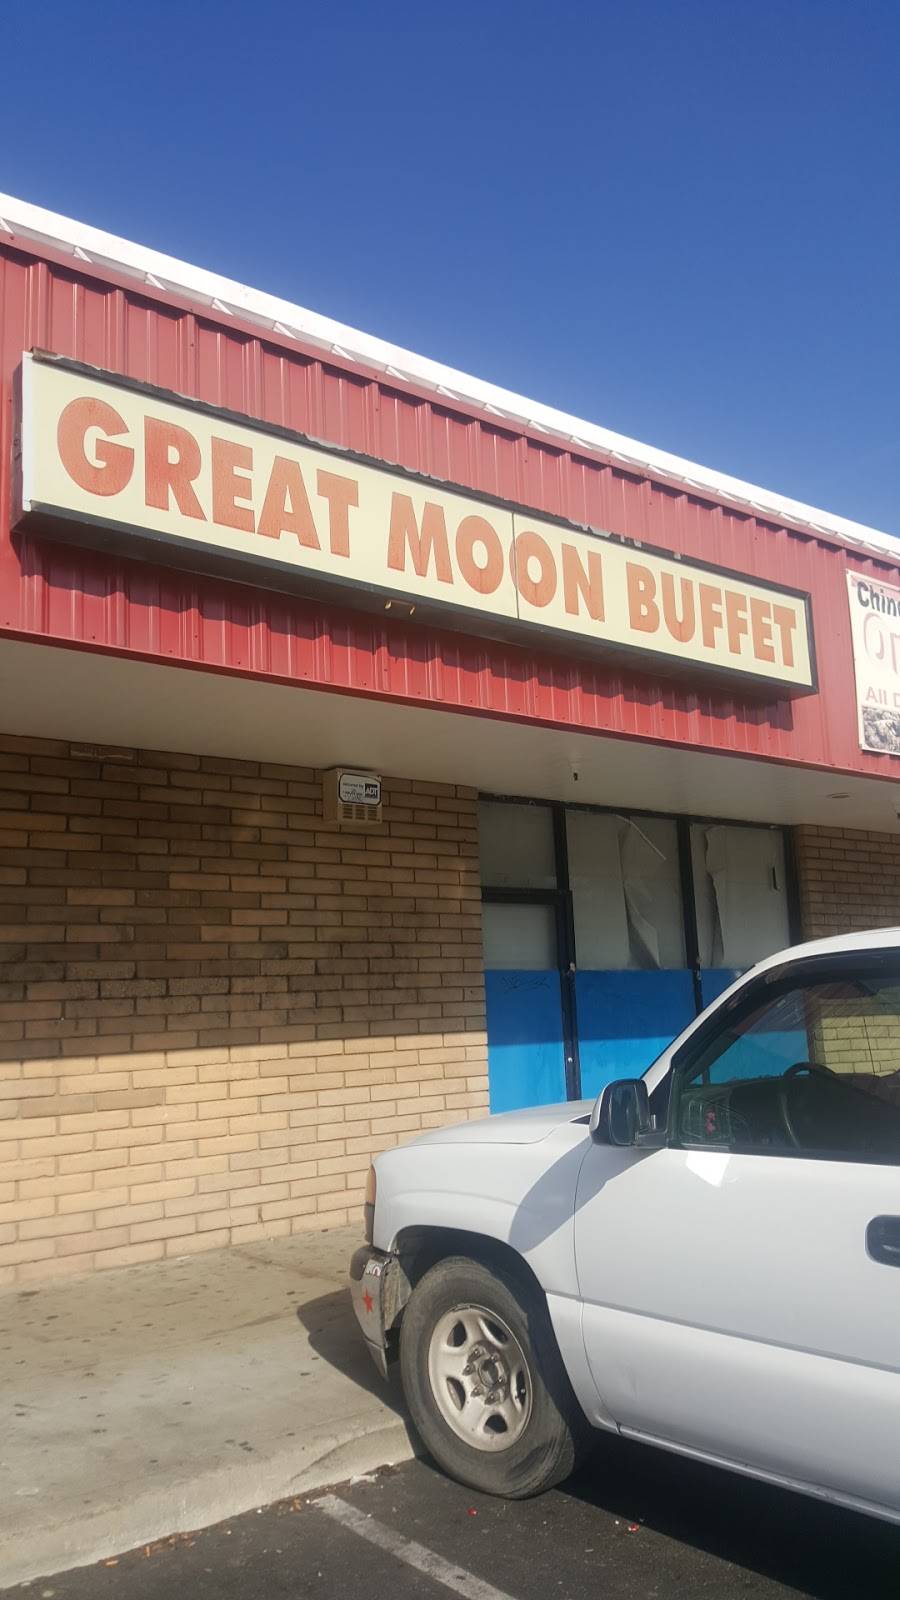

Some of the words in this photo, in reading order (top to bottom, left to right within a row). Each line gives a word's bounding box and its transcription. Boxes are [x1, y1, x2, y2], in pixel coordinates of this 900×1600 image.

[57, 396, 359, 558] GREAT
[387, 491, 605, 622] MOON
[626, 561, 796, 667] BUFFET
[865, 685, 887, 705] All
